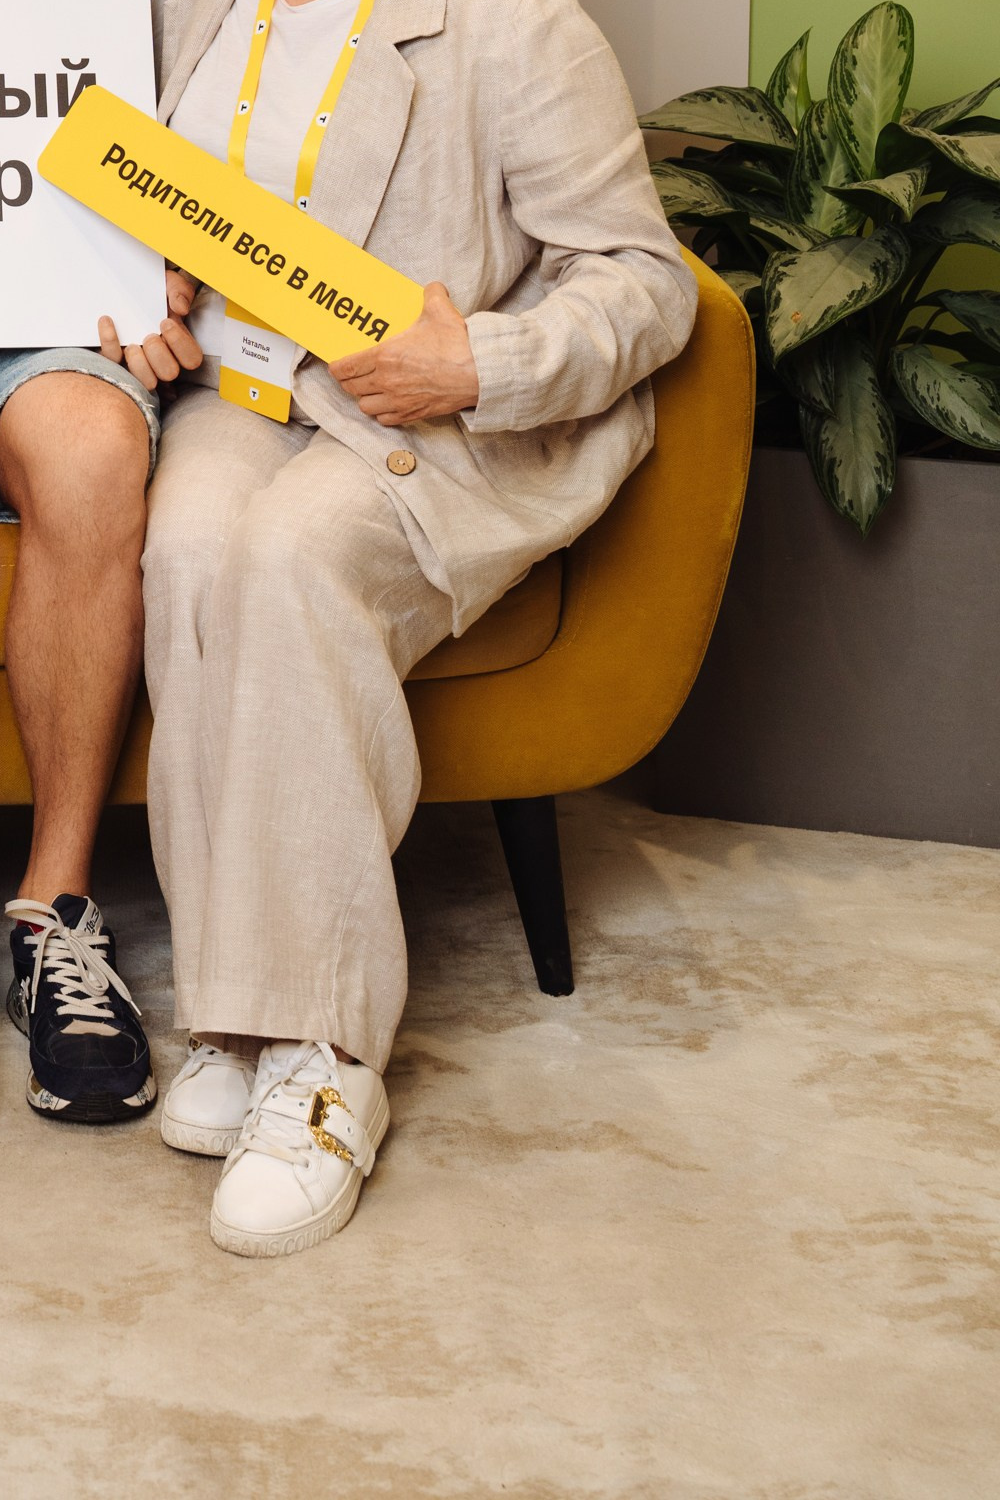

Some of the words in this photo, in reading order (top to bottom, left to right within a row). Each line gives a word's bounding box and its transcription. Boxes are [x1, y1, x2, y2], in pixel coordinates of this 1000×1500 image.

[100, 143, 234, 242] Родители
[232, 231, 286, 276] все
[286, 266, 309, 291] в
[308, 280, 391, 343] меня
[242, 335, 271, 353] Наталья
[241, 346, 270, 364] Ушакова
